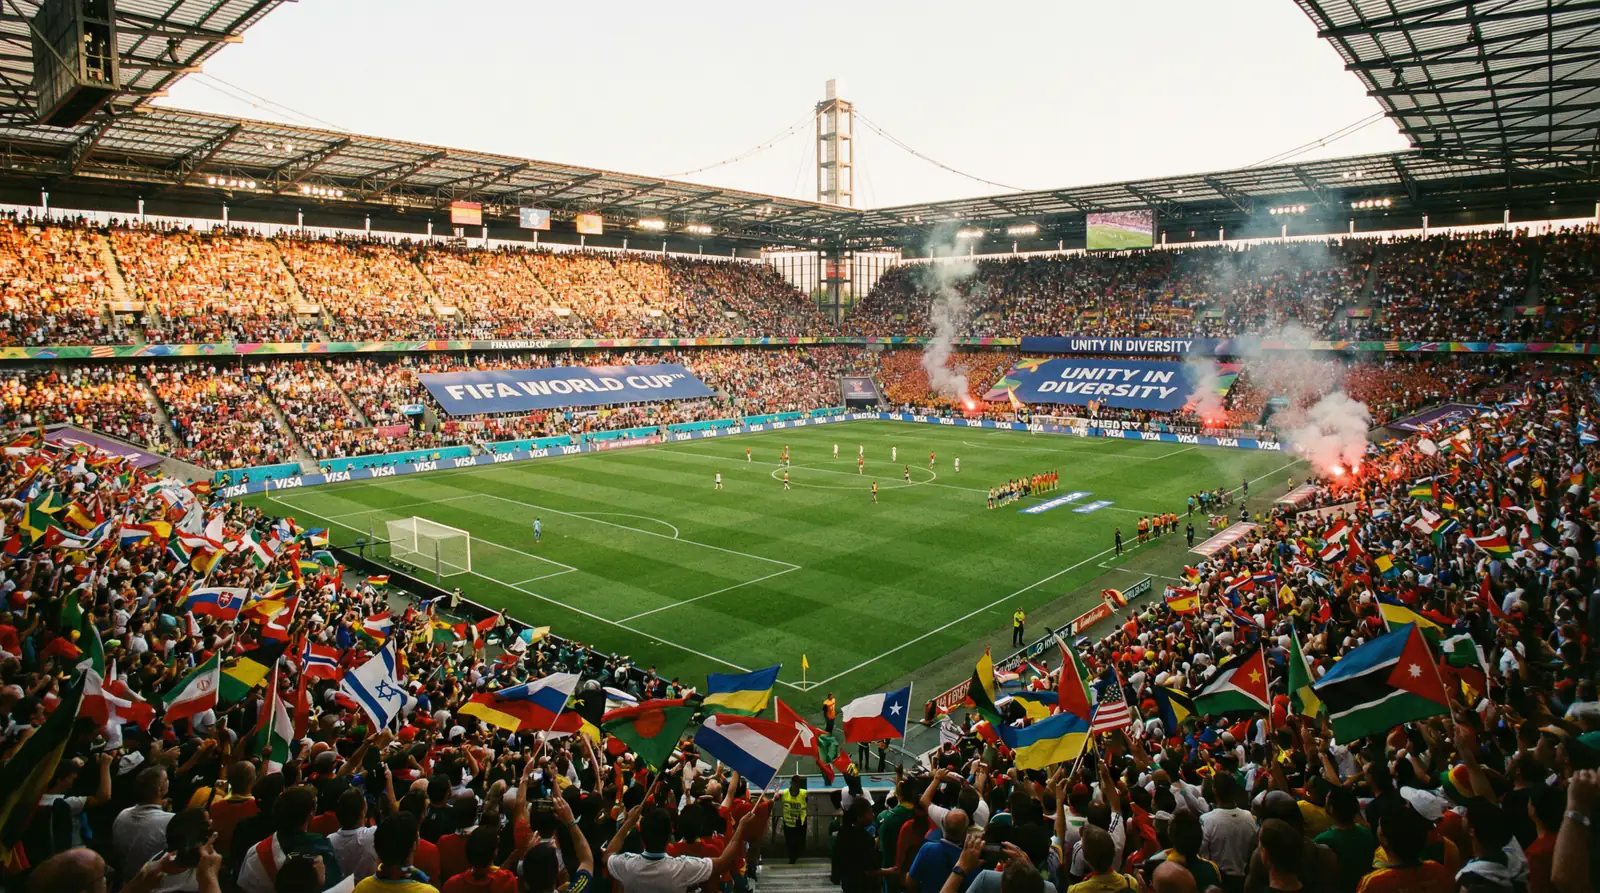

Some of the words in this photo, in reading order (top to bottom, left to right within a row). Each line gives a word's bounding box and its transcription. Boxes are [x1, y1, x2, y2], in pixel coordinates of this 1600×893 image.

[491, 341, 508, 349] FIFA
[1071, 340, 1106, 351] UNITY
[1110, 340, 1124, 352] IN
[1126, 340, 1192, 352] DIVERSITY
[1060, 367, 1141, 381] UNITY
[1142, 370, 1174, 383] IN
[444, 383, 523, 400] FIFA
[517, 377, 625, 396] WORLD
[1037, 380, 1178, 400] DIVERSITY
[1104, 428, 1125, 438] VISA
[1140, 431, 1160, 440] VISA
[1176, 434, 1198, 444] VISA
[1216, 437, 1239, 448] VISA
[562, 444, 581, 454] VISA
[1257, 440, 1281, 450] VISA
[492, 452, 514, 463] VISA
[528, 448, 548, 458] VISA
[414, 460, 437, 472] VISA
[454, 456, 476, 467] VISA
[324, 471, 351, 483] VISA
[370, 465, 396, 478] VISA
[273, 476, 302, 490] VISA
